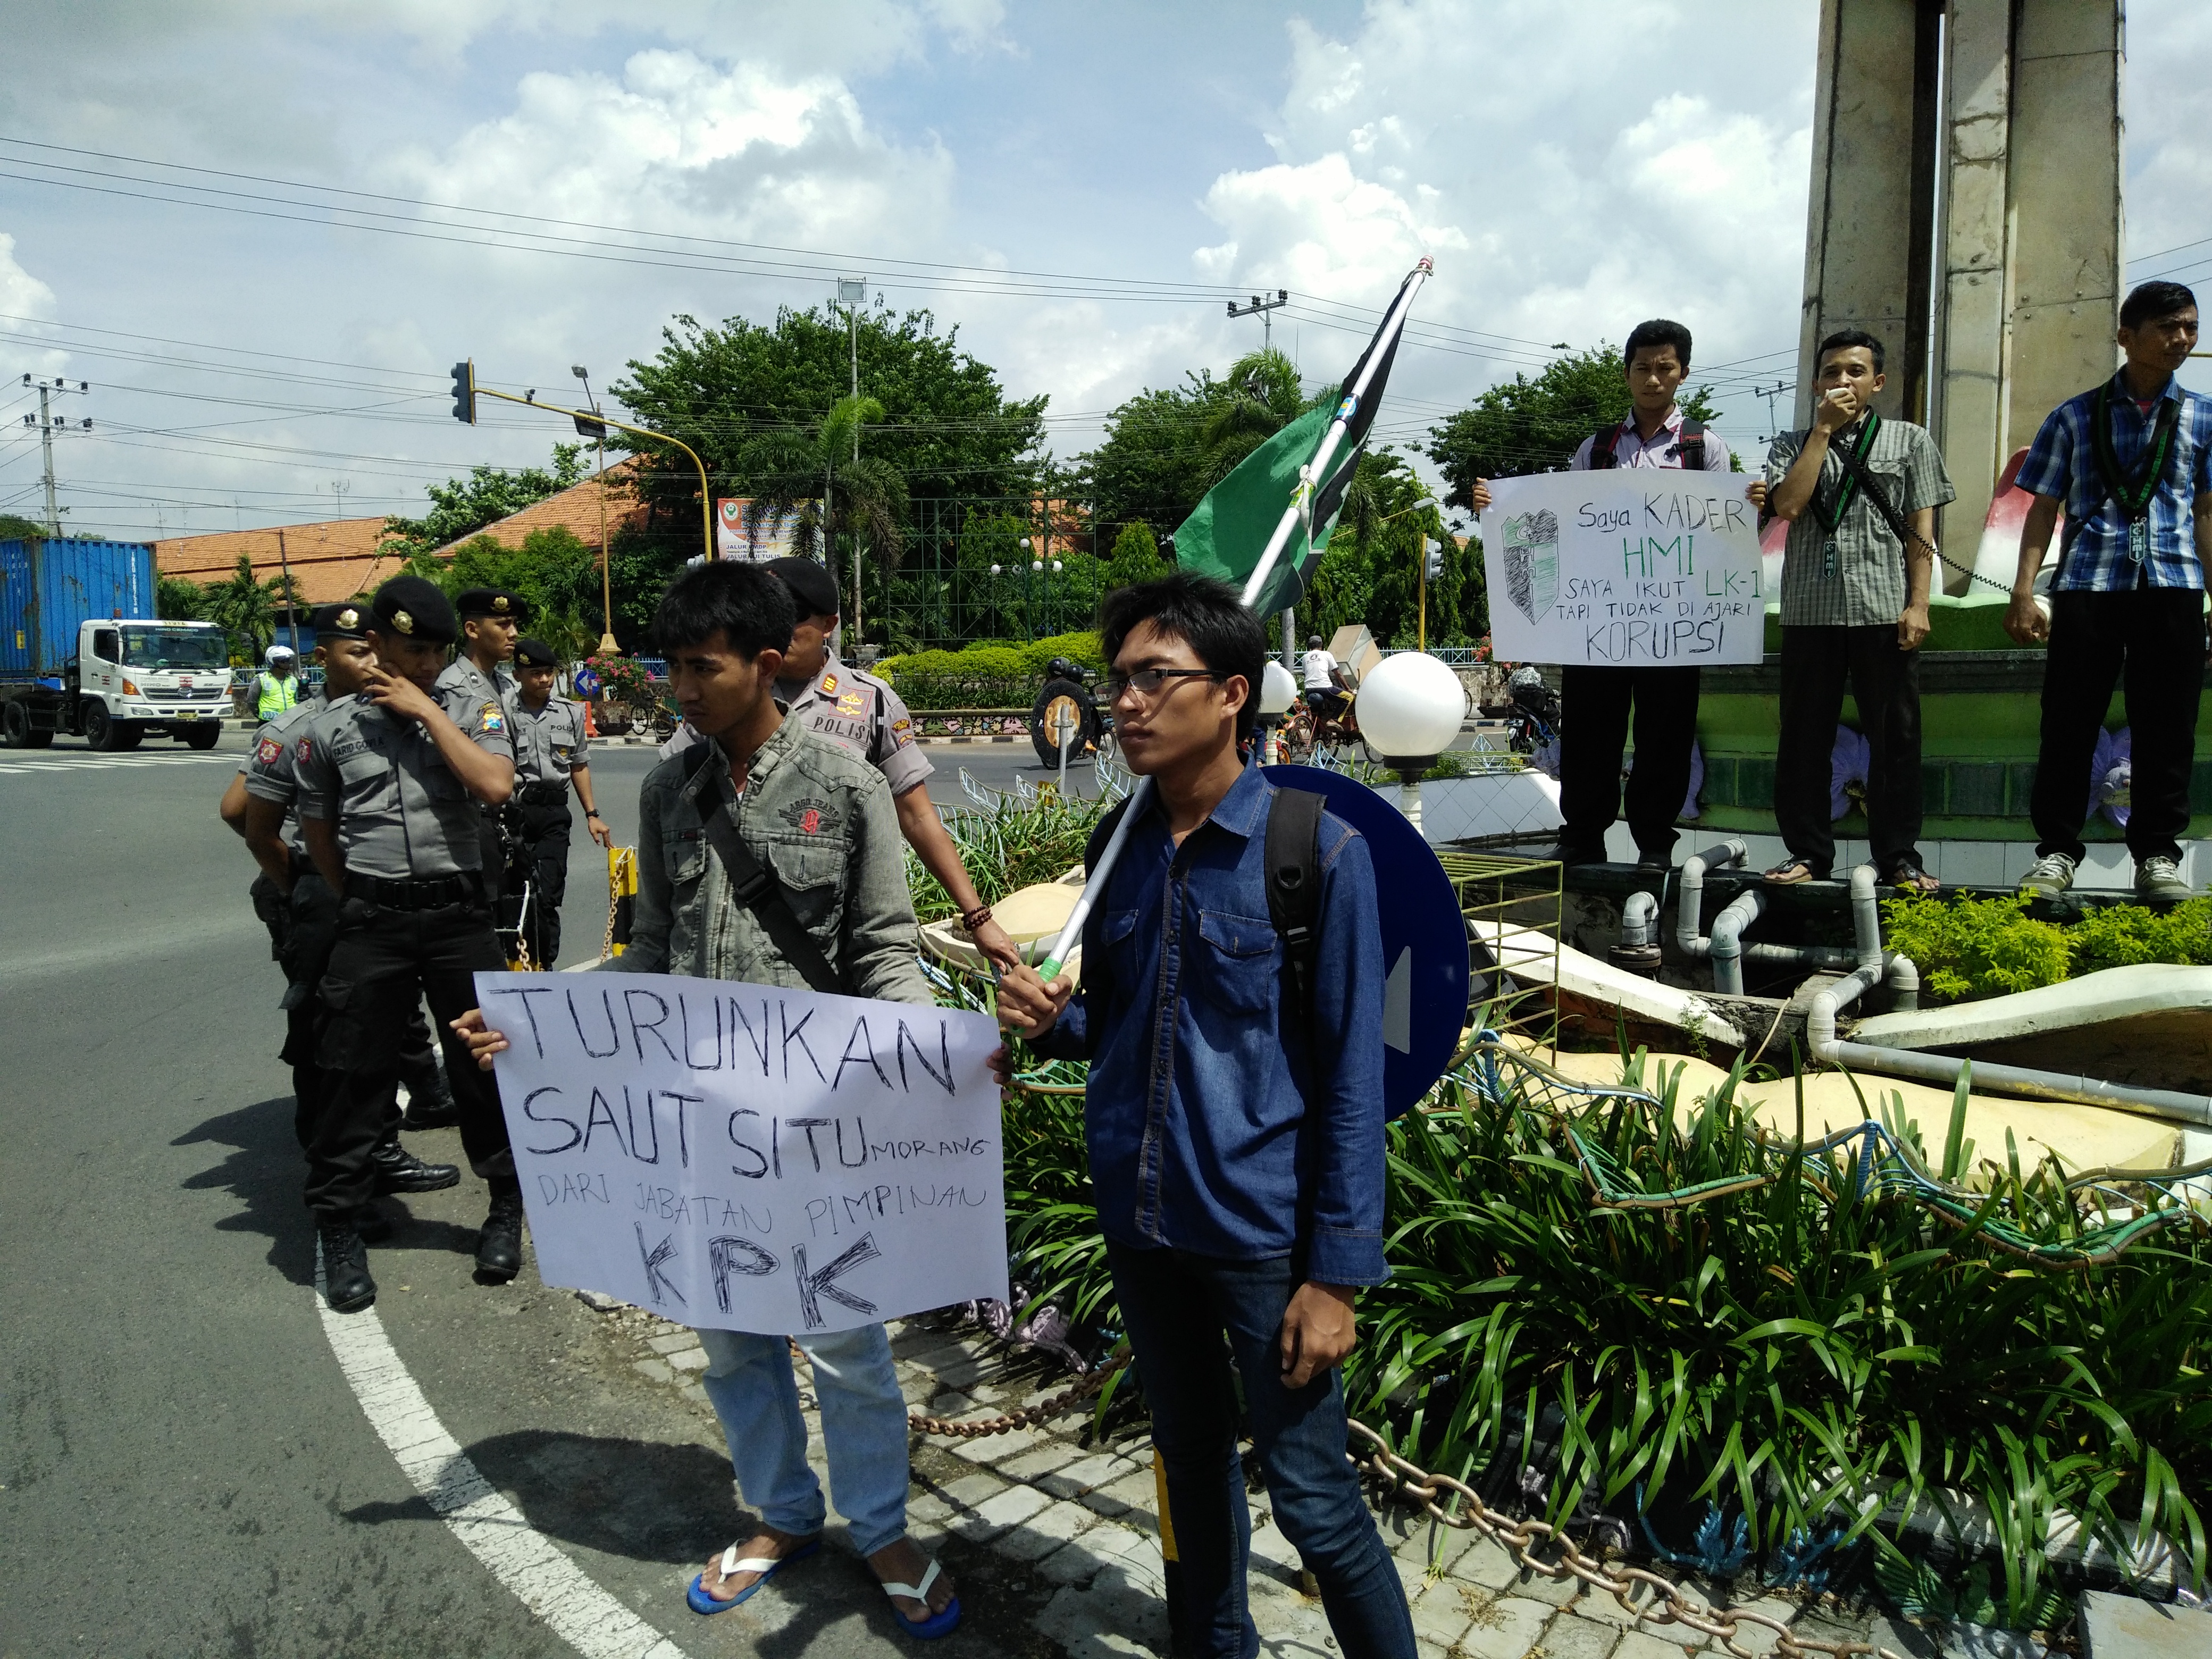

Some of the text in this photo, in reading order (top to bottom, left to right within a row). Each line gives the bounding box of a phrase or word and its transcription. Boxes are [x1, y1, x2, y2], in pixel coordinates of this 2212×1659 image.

[1578, 492, 1748, 532] Saya KADER
[1623, 535, 1694, 580] HMI
[1564, 569, 1761, 599] SAYA IKUT LK-1
[1556, 601, 1751, 622] TAPI TIDAK DI AJARI
[1586, 620, 1725, 661] KORUPSI
[813, 716, 870, 743] POLISI
[490, 987, 956, 1095] TURUNKAN
[523, 1085, 991, 1179] SAUT SITUMORANG
[538, 1174, 986, 1237] DARI JABATAN PIMPINAN
[634, 1222, 882, 1330] KPK
